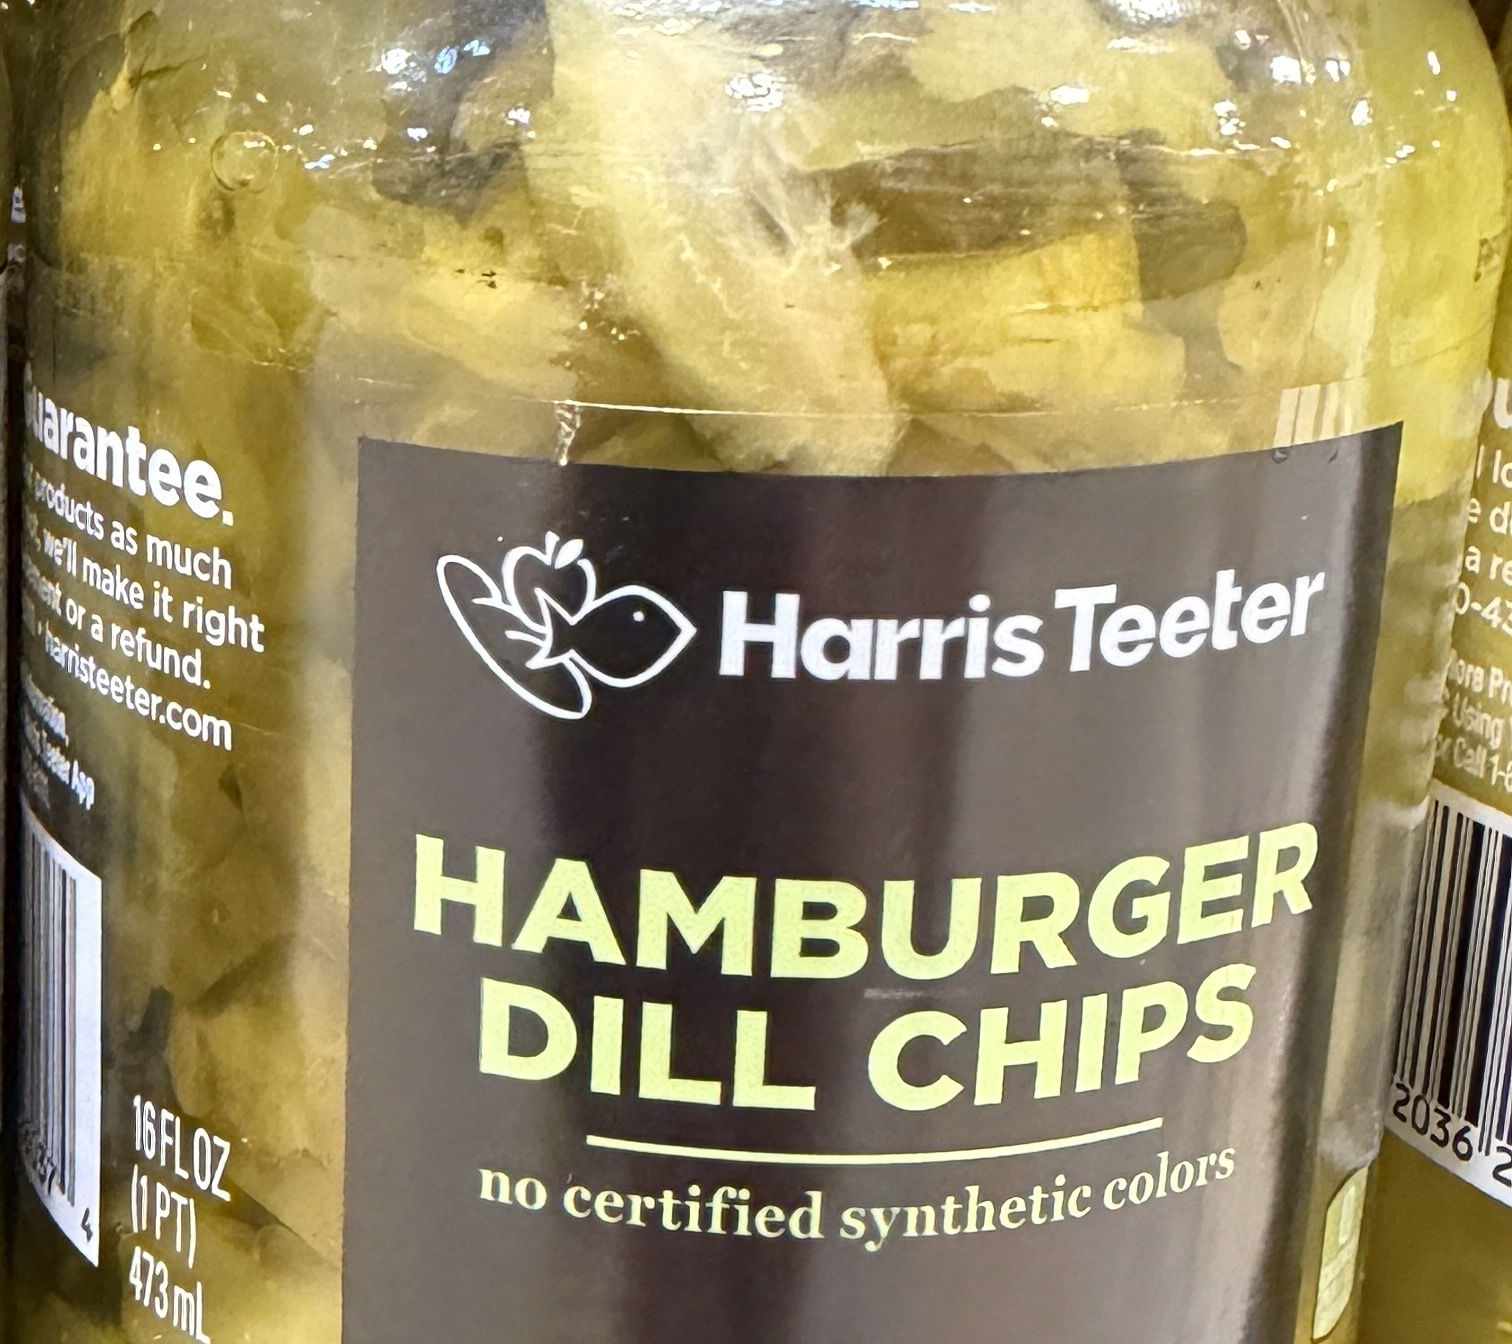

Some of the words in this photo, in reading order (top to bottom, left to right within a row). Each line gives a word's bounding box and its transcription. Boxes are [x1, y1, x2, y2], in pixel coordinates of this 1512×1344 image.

[82, 557, 145, 610] make
[152, 580, 174, 624] it
[183, 595, 266, 653] right
[110, 519, 138, 556] as
[146, 533, 233, 591] much
[65, 597, 87, 631] or
[90, 613, 104, 643] a
[111, 622, 212, 690] refund.
[718, 589, 1046, 683] Harris
[1054, 567, 1325, 674] Teeter
[44, 620, 234, 752] harristeeter.com
[411, 821, 1321, 981] HAMBURGER
[478, 977, 817, 1113] DILL
[866, 961, 1256, 1113] CHIPS
[133, 1094, 156, 1161] 16
[160, 1108, 190, 1181] FL
[192, 1126, 232, 1203] OZ
[1391, 1082, 1475, 1163] 2036
[131, 1163, 148, 1234] (1
[155, 1181, 197, 1270] PT)
[478, 1166, 548, 1212] no
[563, 1180, 825, 1240] certified
[839, 1174, 1093, 1253] synthetic
[1101, 1146, 1237, 1212] colors
[129, 1245, 169, 1320] 473
